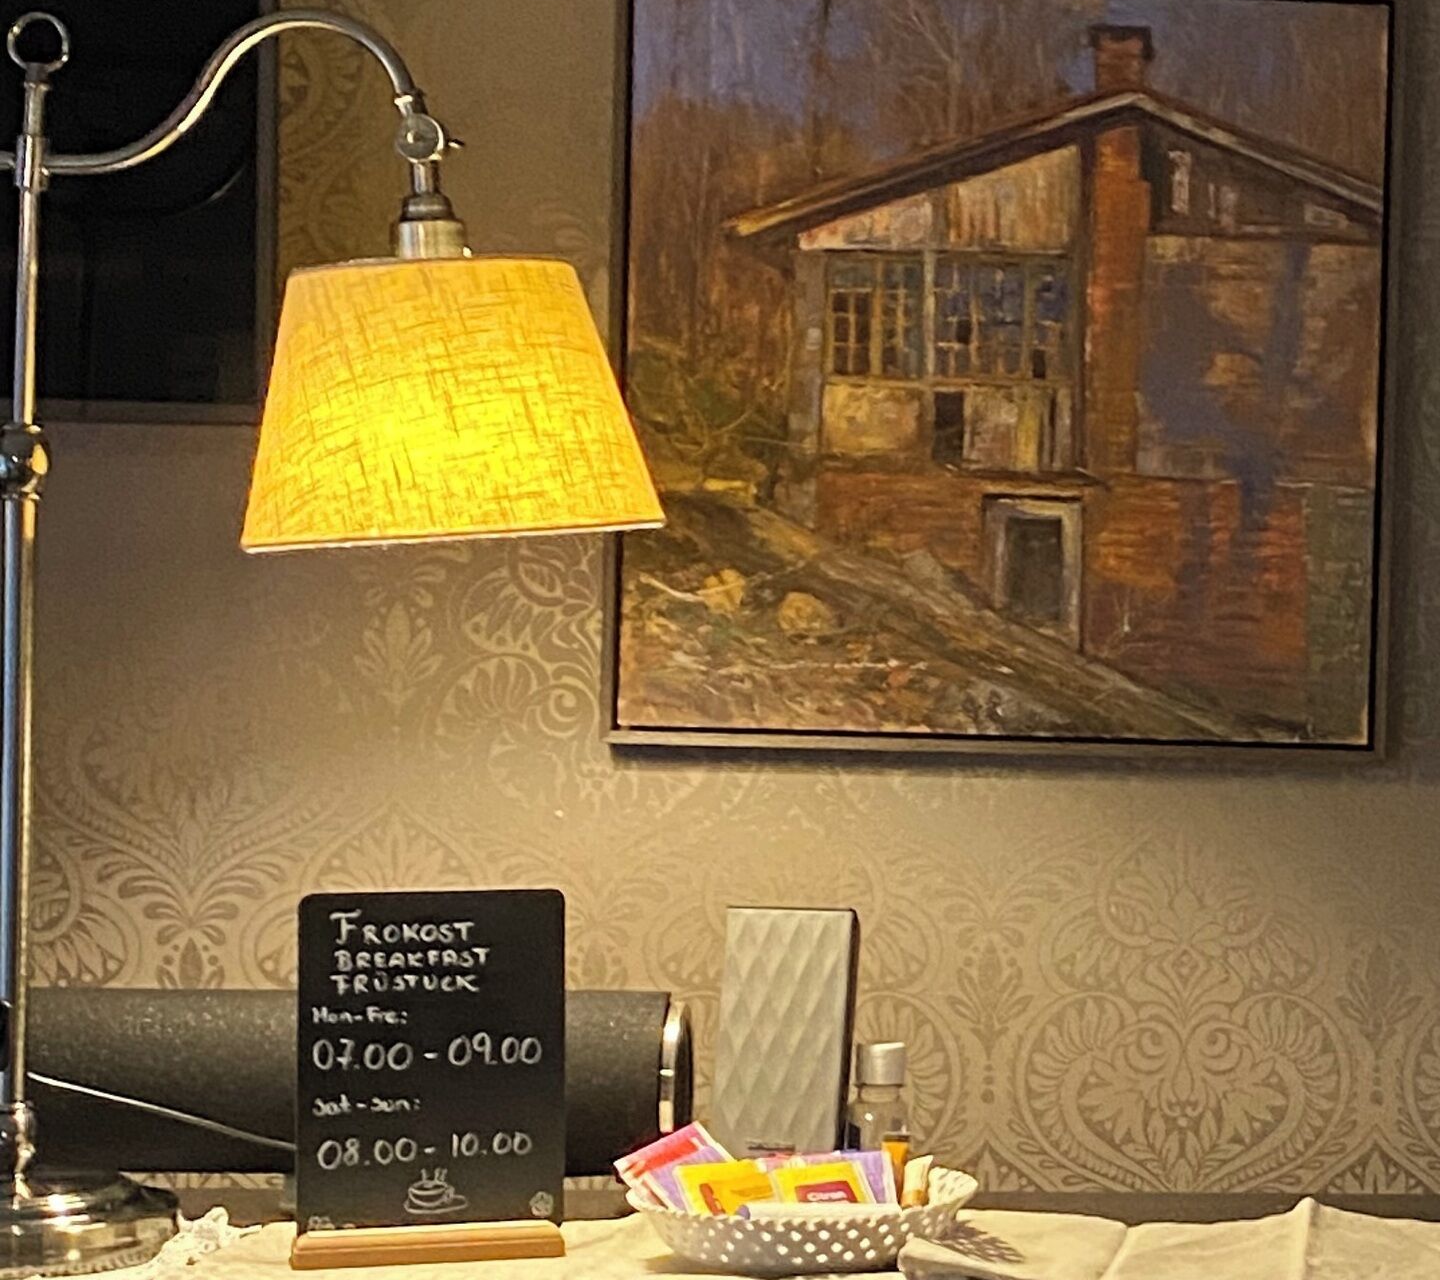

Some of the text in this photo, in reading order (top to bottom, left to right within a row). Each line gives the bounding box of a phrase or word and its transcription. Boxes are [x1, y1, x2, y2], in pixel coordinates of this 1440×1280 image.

[333, 947, 490, 972] BREAKFAST
[311, 1037, 414, 1071] 07.00
[448, 1031, 543, 1067] 09.00
[316, 1136, 418, 1171] 08.00
[452, 1131, 533, 1159] 10.00
